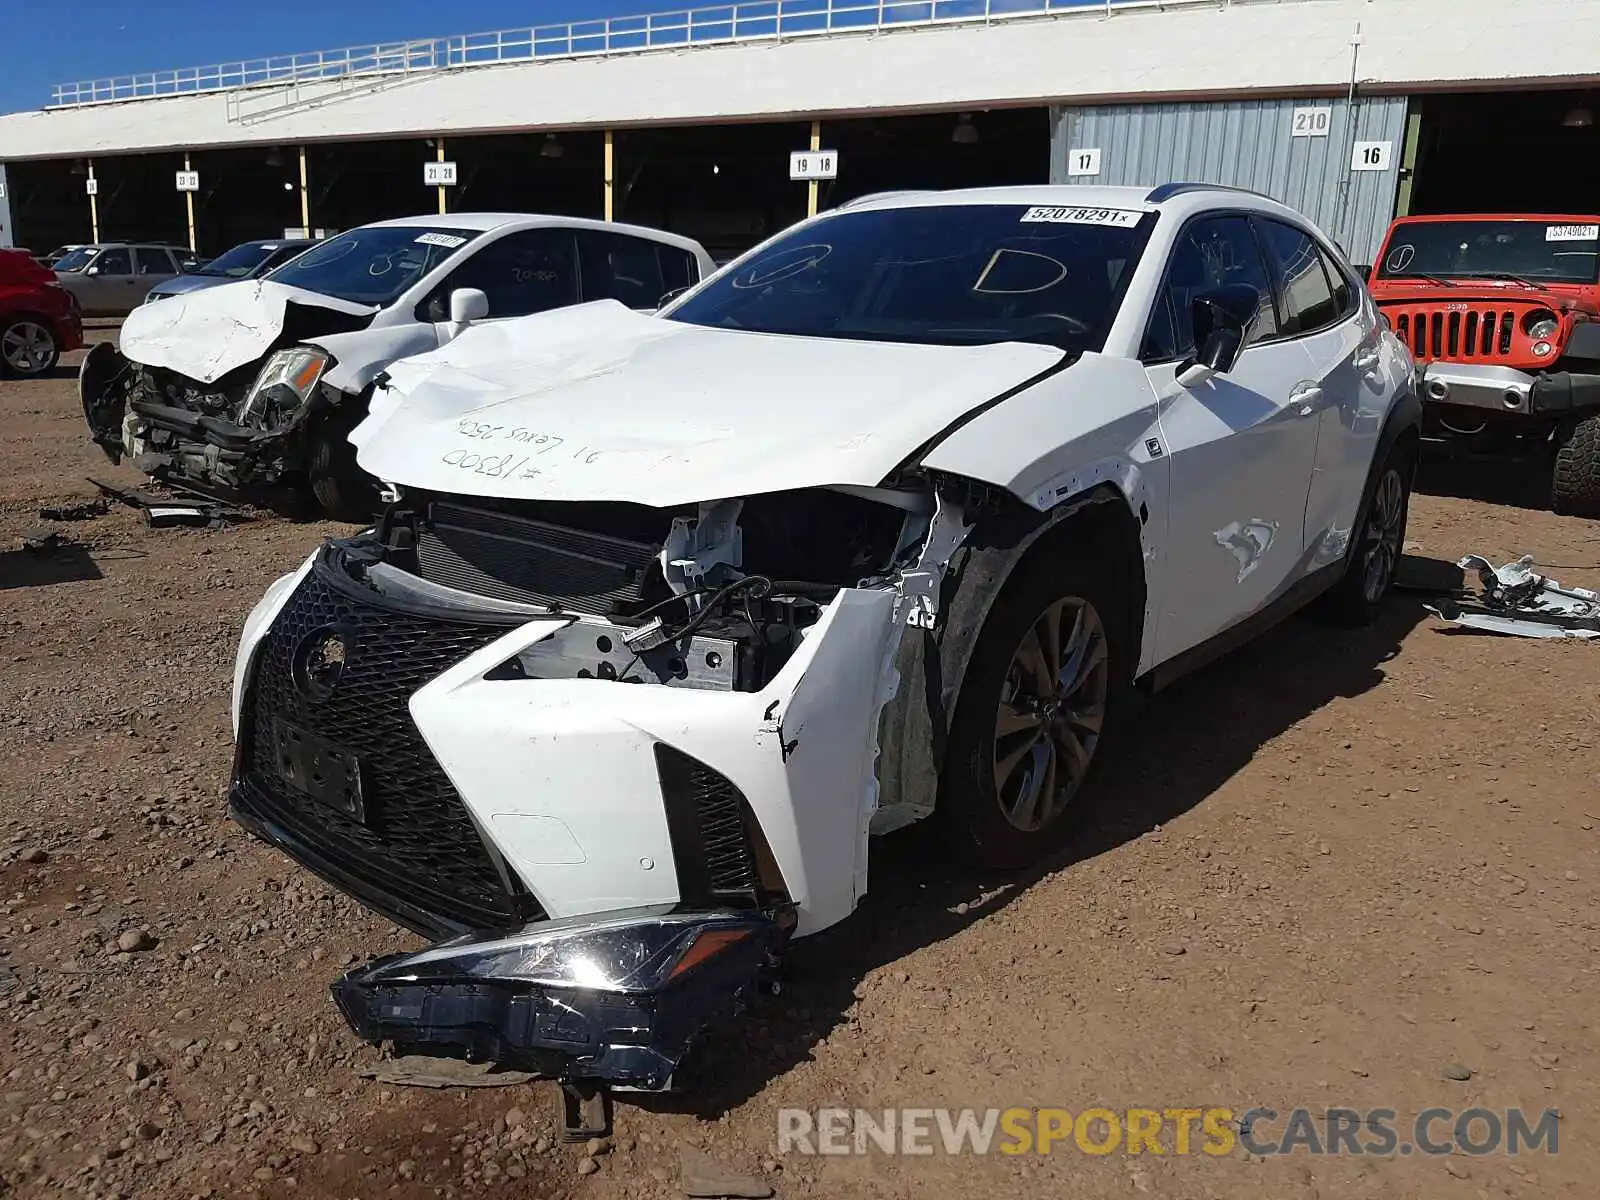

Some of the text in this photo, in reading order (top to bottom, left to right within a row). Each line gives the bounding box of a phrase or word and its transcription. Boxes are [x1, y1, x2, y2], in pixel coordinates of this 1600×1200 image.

[1296, 113, 1327, 130] 210
[1079, 154, 1091, 169] 17
[1363, 147, 1381, 164] 16
[798, 158, 831, 172] 19 18
[429, 168, 437, 179] 21
